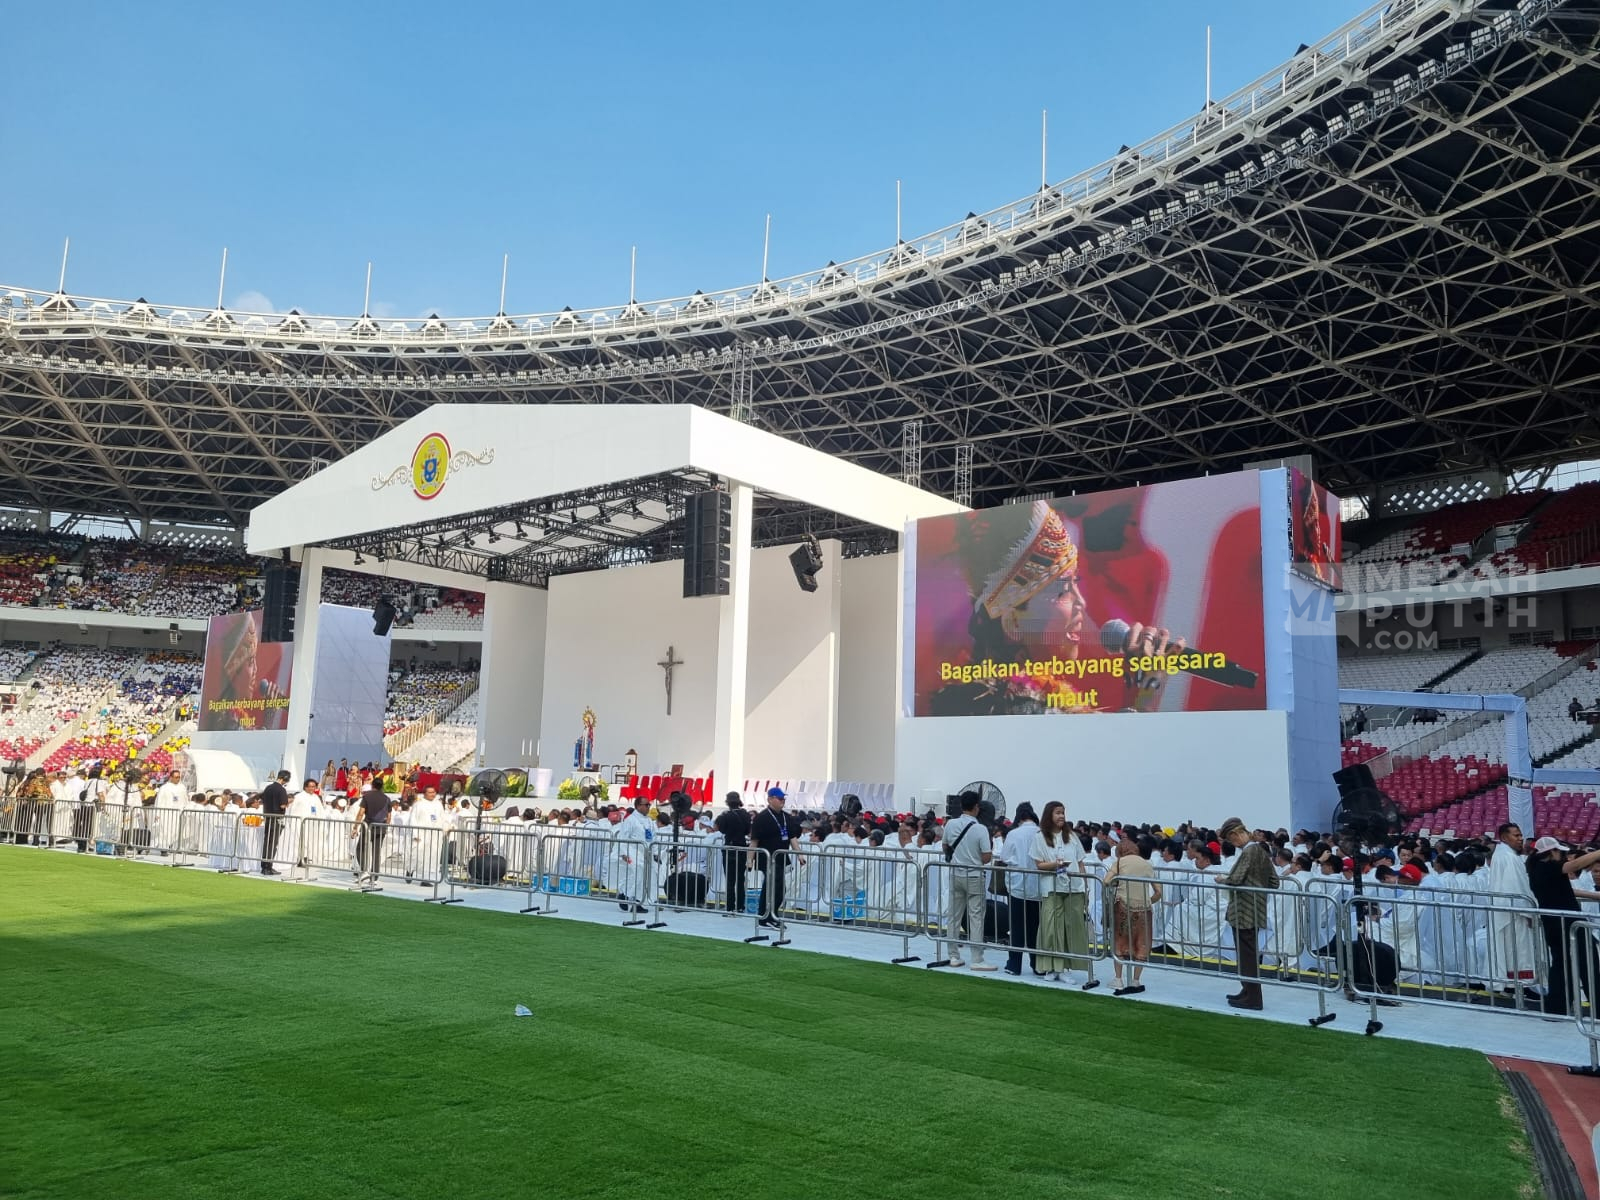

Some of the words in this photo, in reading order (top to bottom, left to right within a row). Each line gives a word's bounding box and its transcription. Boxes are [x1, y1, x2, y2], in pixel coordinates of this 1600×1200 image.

[941, 660, 1020, 682] Bagaikan
[1024, 655, 1124, 677] terbayang
[1129, 653, 1226, 675] sengsara
[1046, 689, 1098, 708] maut
